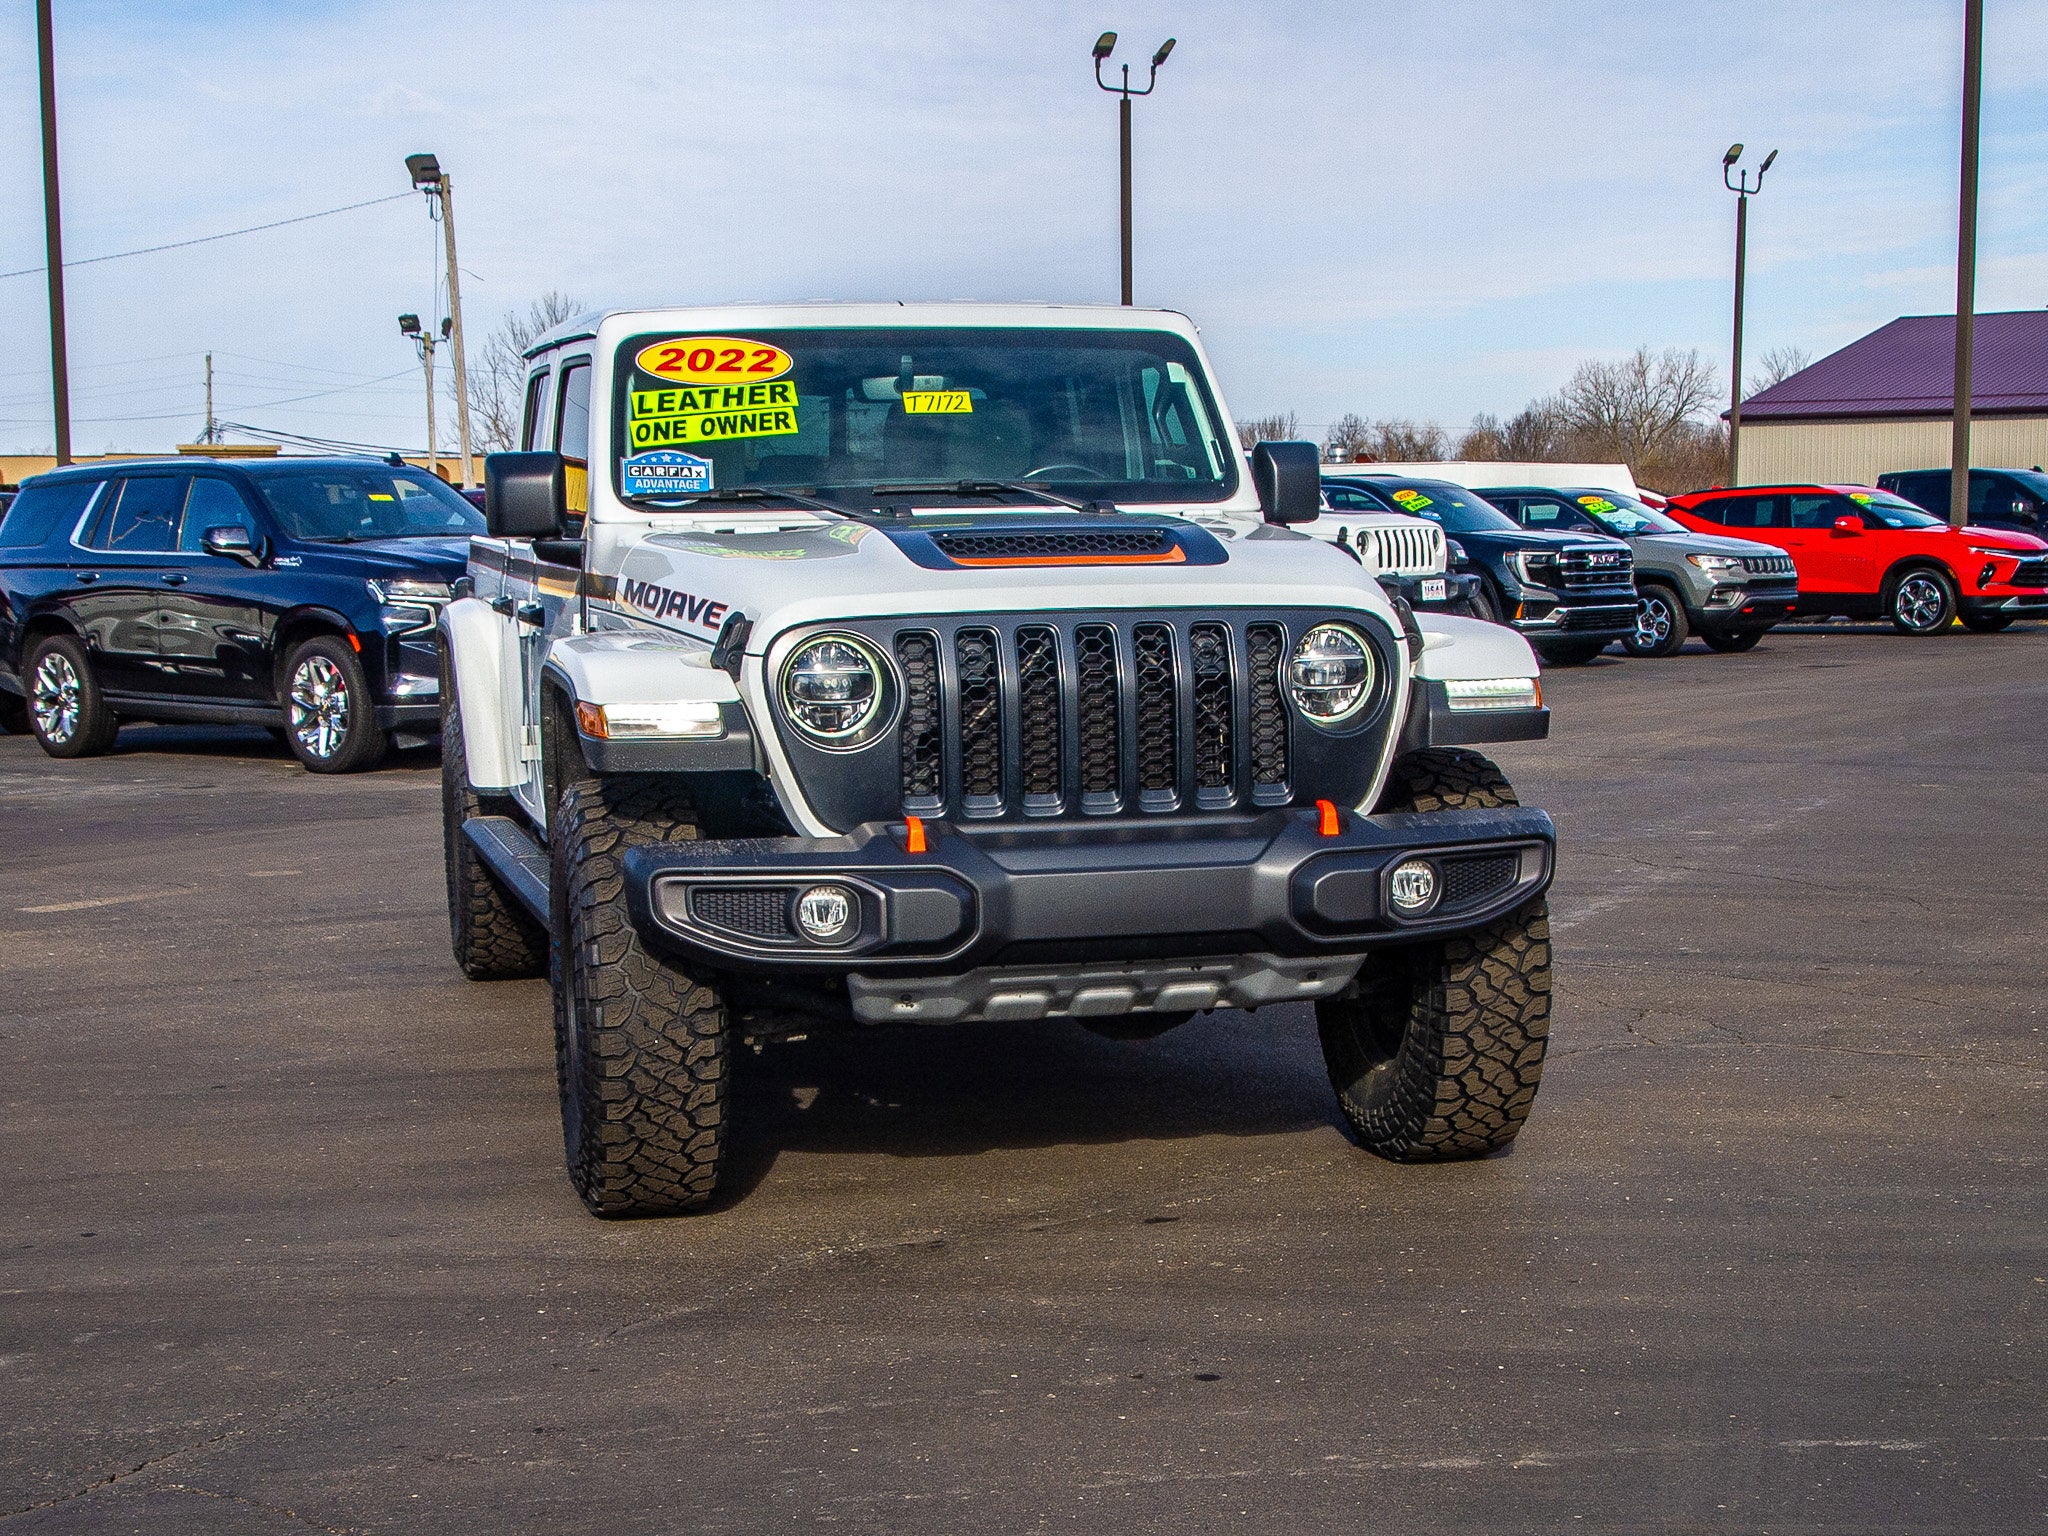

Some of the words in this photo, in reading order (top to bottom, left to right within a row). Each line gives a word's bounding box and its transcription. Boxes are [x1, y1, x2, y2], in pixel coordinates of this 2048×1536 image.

[654, 347, 777, 373] 2022
[636, 383, 792, 415] LEATHER
[906, 394, 968, 412] T7172
[635, 419, 687, 443] ONE
[700, 411, 792, 437] OWNER
[628, 465, 704, 478] CARFAX
[634, 478, 701, 490] ADVANTAGE
[623, 578, 729, 631] MOJAVE
